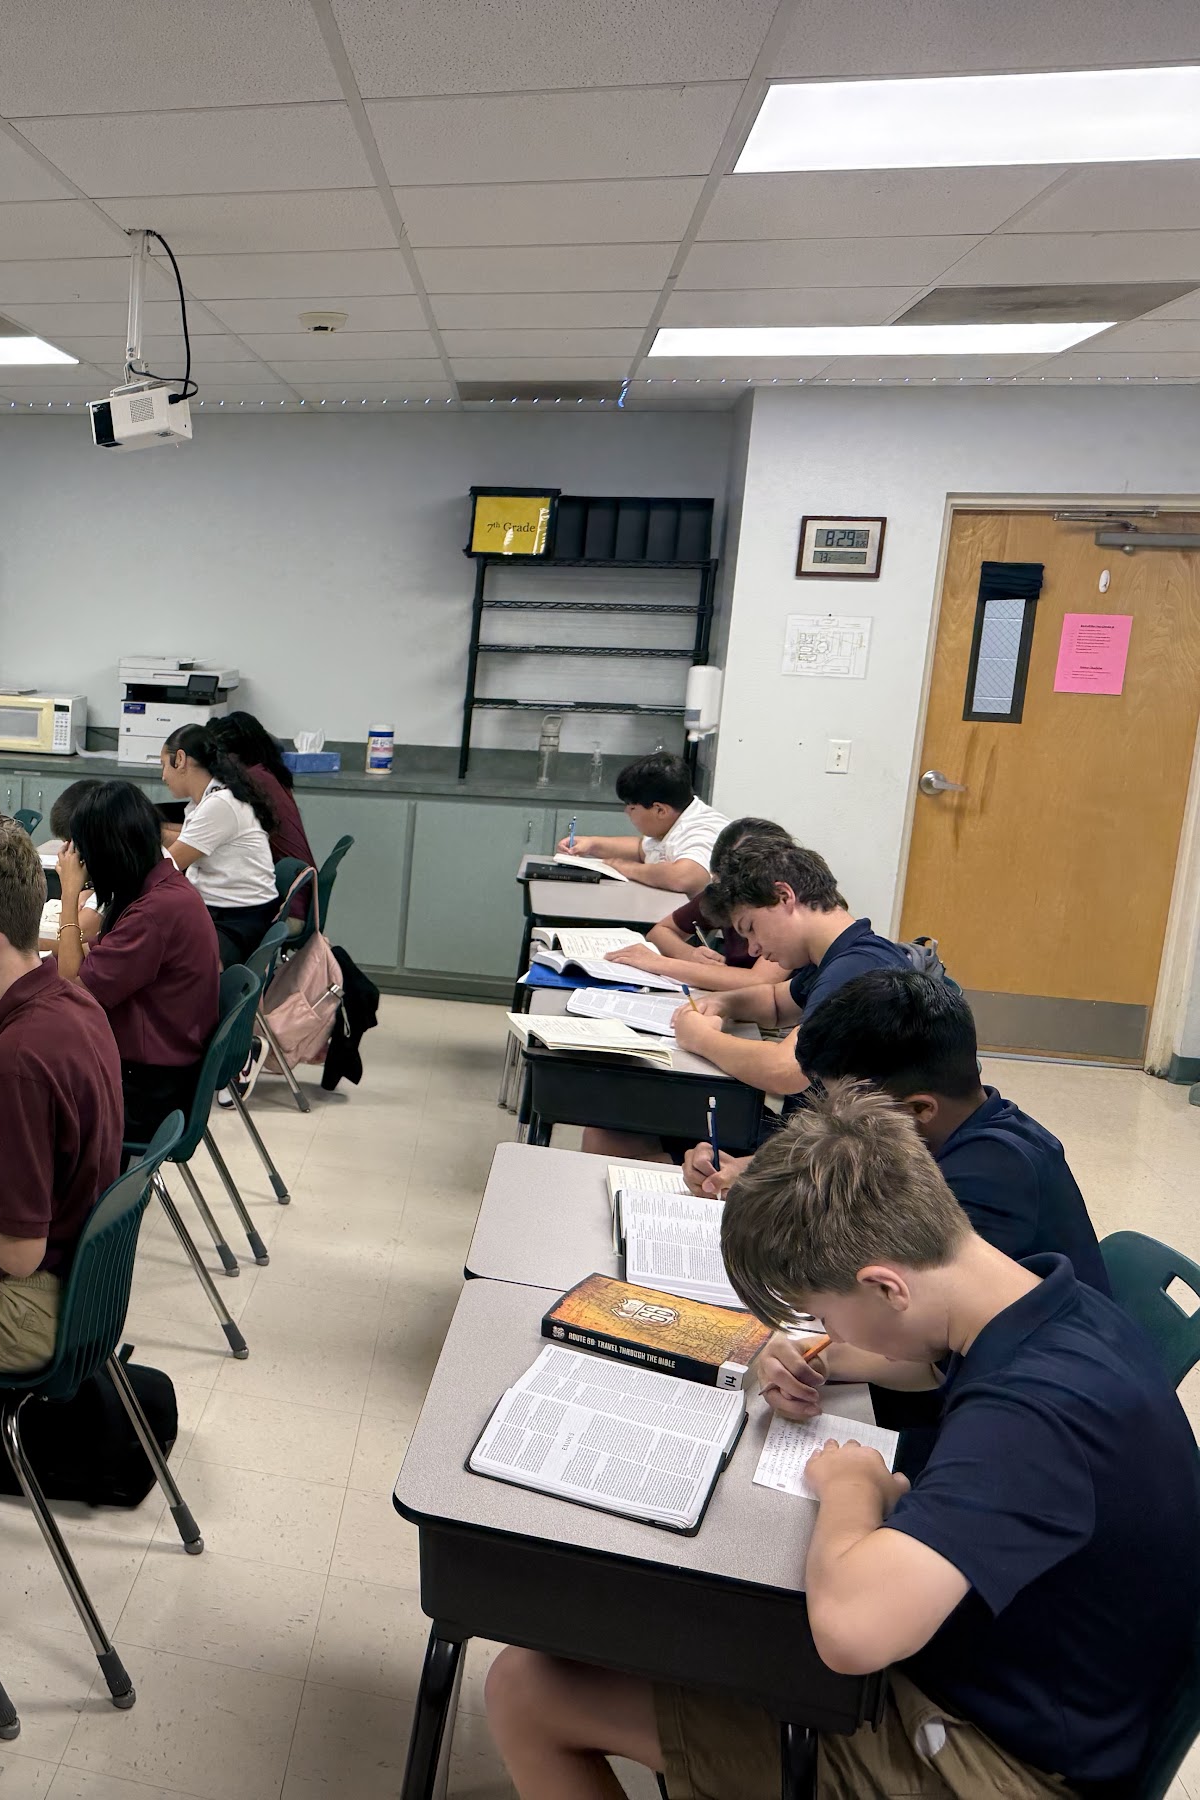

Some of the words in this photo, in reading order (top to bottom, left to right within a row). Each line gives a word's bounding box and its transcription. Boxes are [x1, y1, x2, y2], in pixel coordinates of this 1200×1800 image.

[487, 522, 500, 533] 7th
[503, 522, 536, 533] Grade
[568, 1332, 586, 1344] ROUTE
[597, 1339, 619, 1353] TRAVEL
[619, 1345, 646, 1360] THROUGH
[646, 1353, 658, 1364] THE
[658, 1356, 676, 1369] BIBLE
